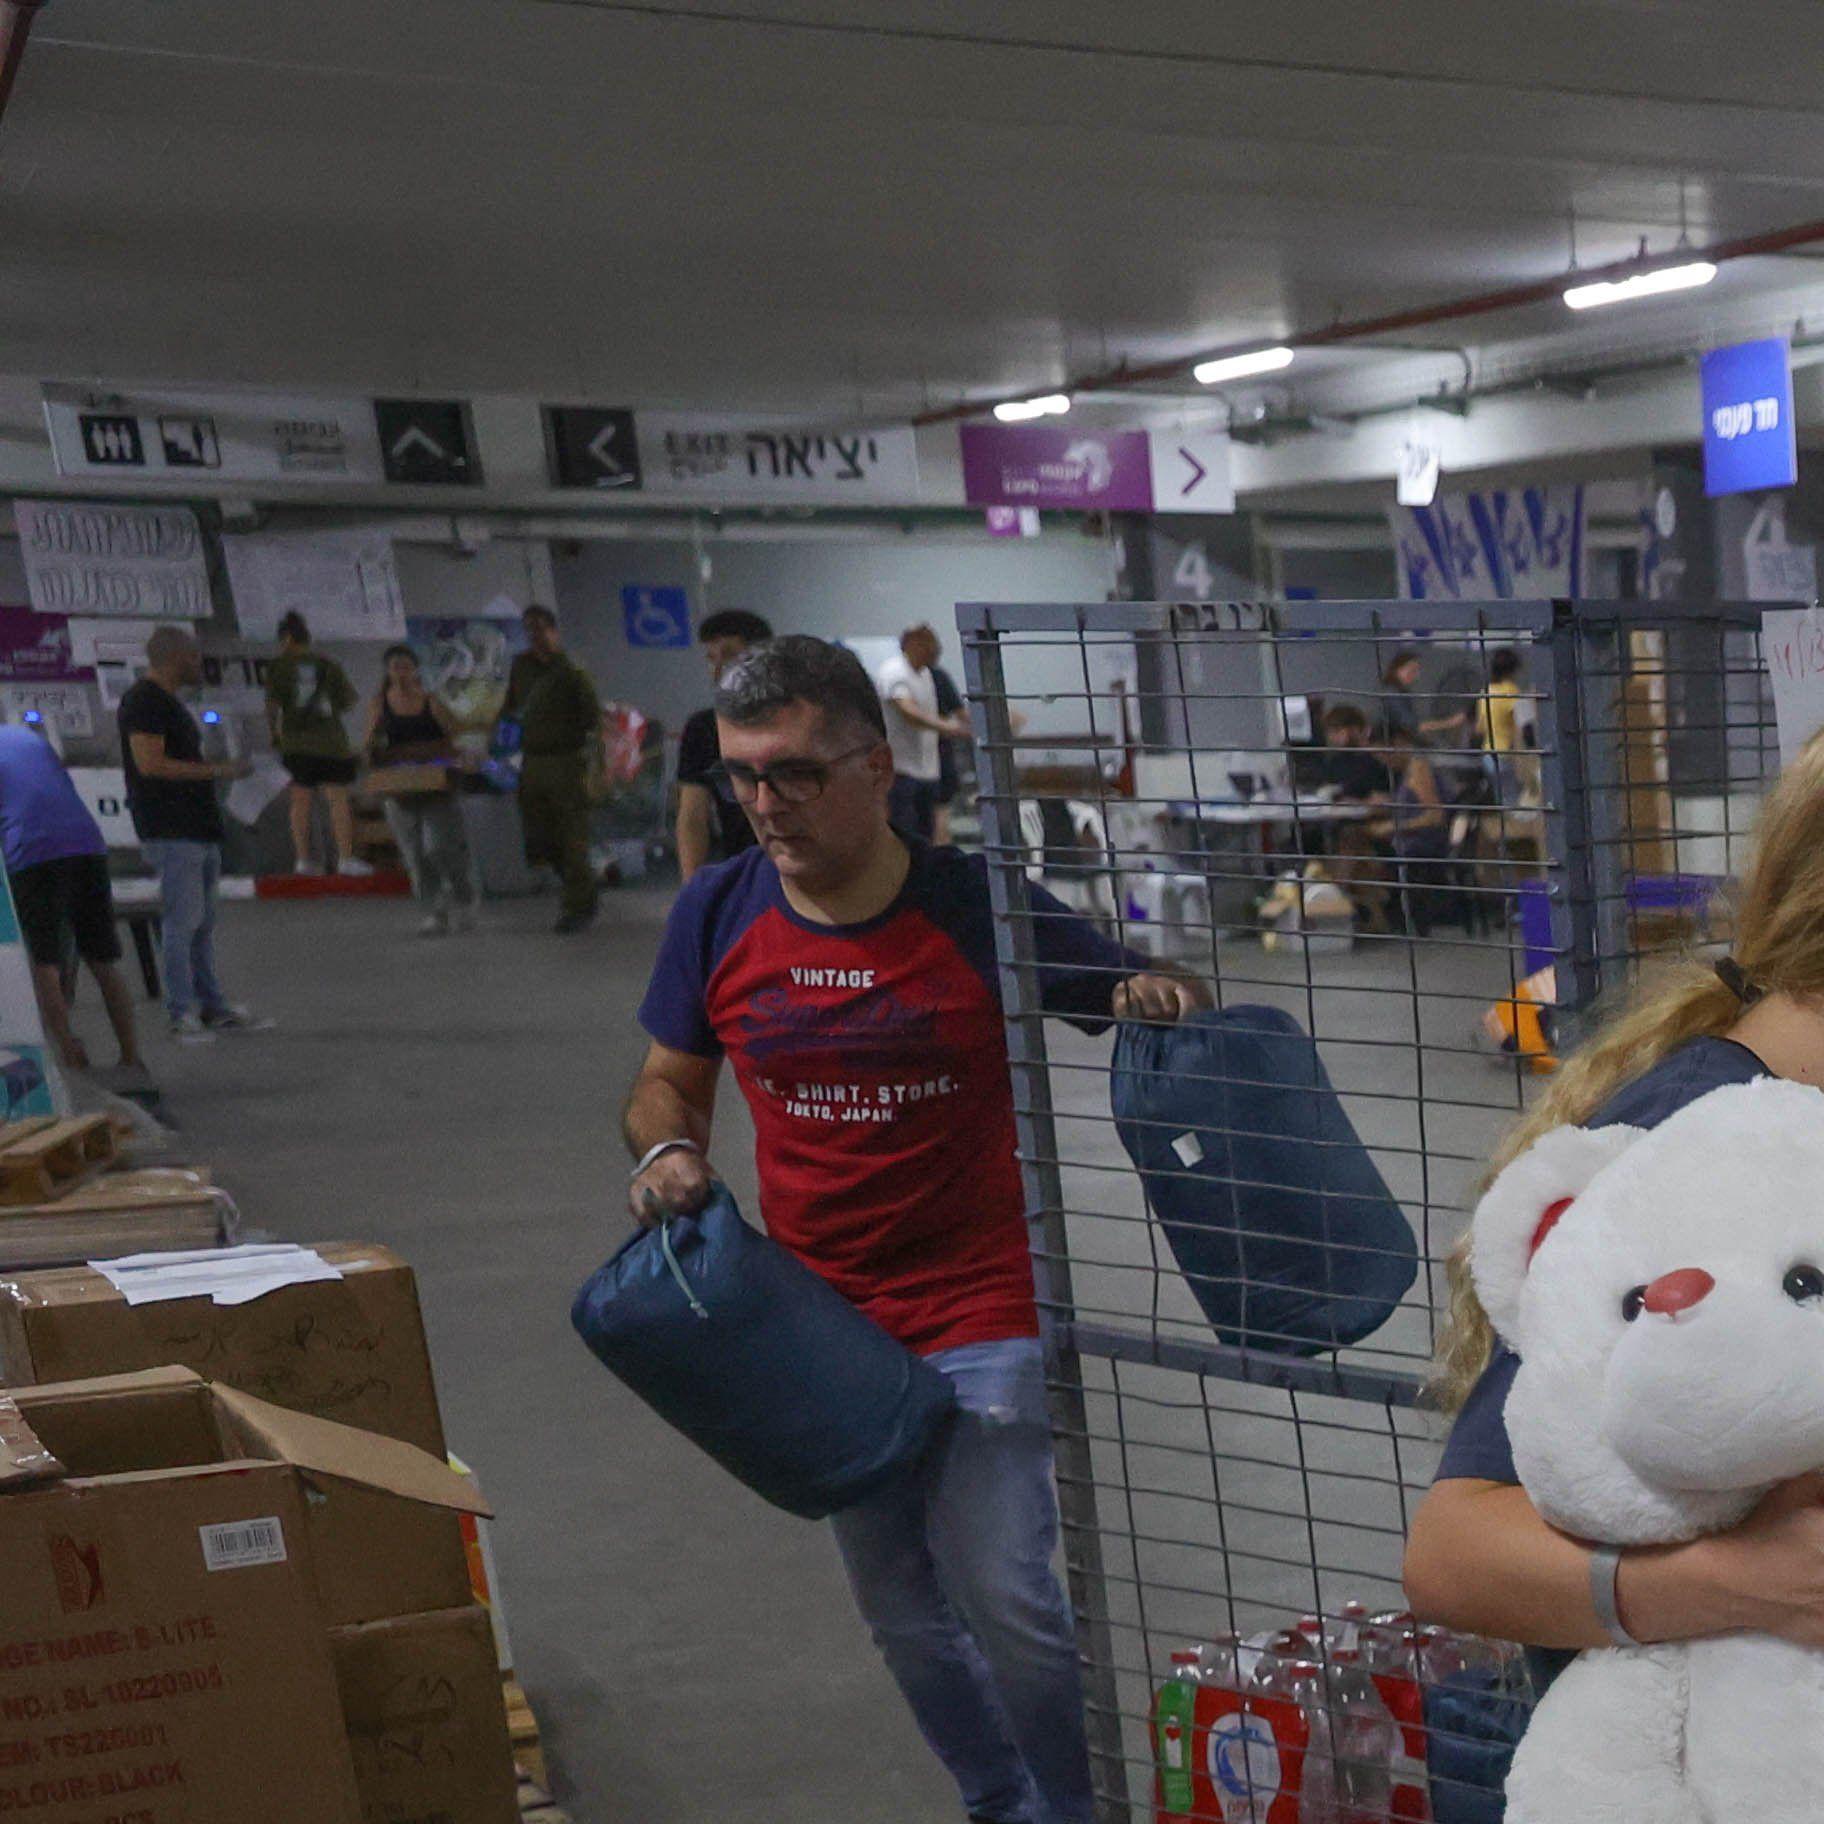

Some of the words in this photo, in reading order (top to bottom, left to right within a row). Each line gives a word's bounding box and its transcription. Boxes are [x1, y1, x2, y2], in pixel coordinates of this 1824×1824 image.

[745, 430, 879, 481] יציאה
[1174, 546, 1214, 599] 4
[790, 967, 875, 988] VINTAGE
[877, 1075, 960, 1104] STORE.
[786, 1101, 835, 1121] TOKYO,
[97, 1758, 185, 1796] BLACK
